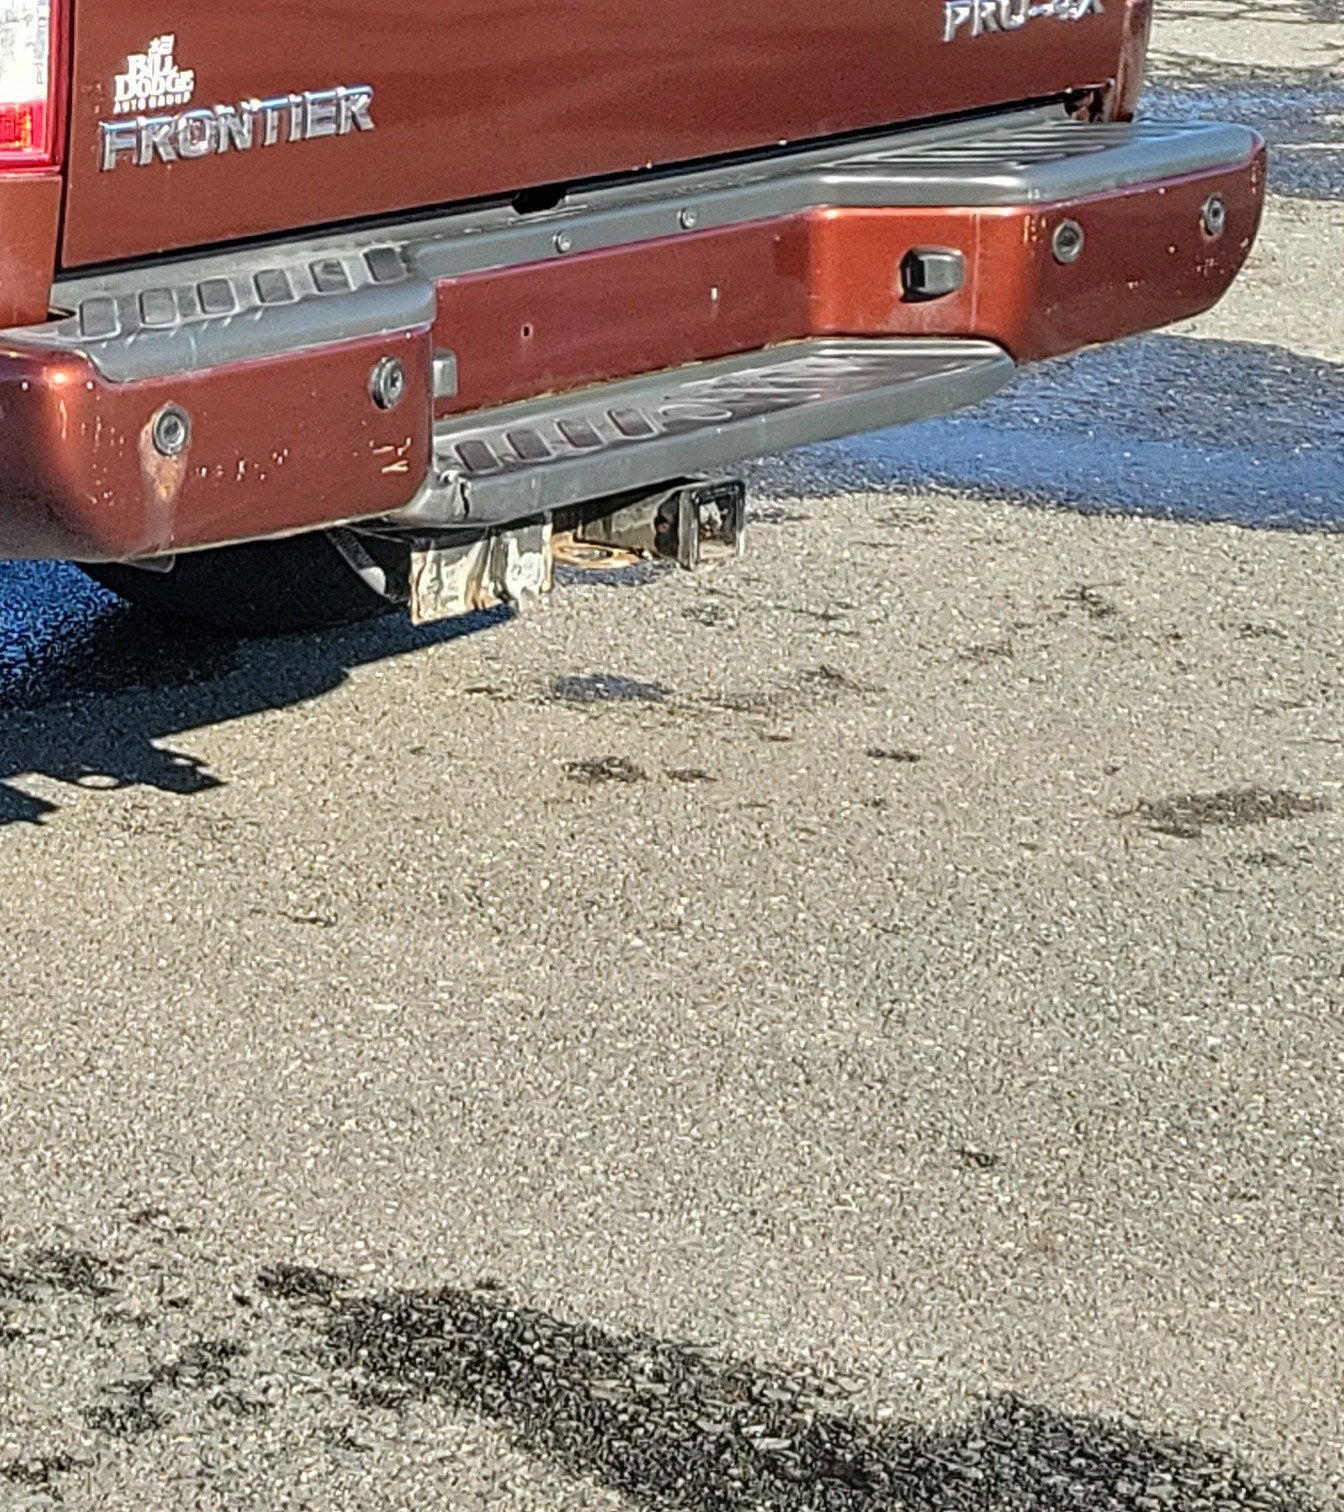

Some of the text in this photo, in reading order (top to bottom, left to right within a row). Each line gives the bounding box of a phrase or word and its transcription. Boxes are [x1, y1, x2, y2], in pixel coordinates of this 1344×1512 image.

[126, 52, 174, 78] BILL
[113, 68, 195, 103] DODGE
[98, 82, 376, 173] FRONTIER
